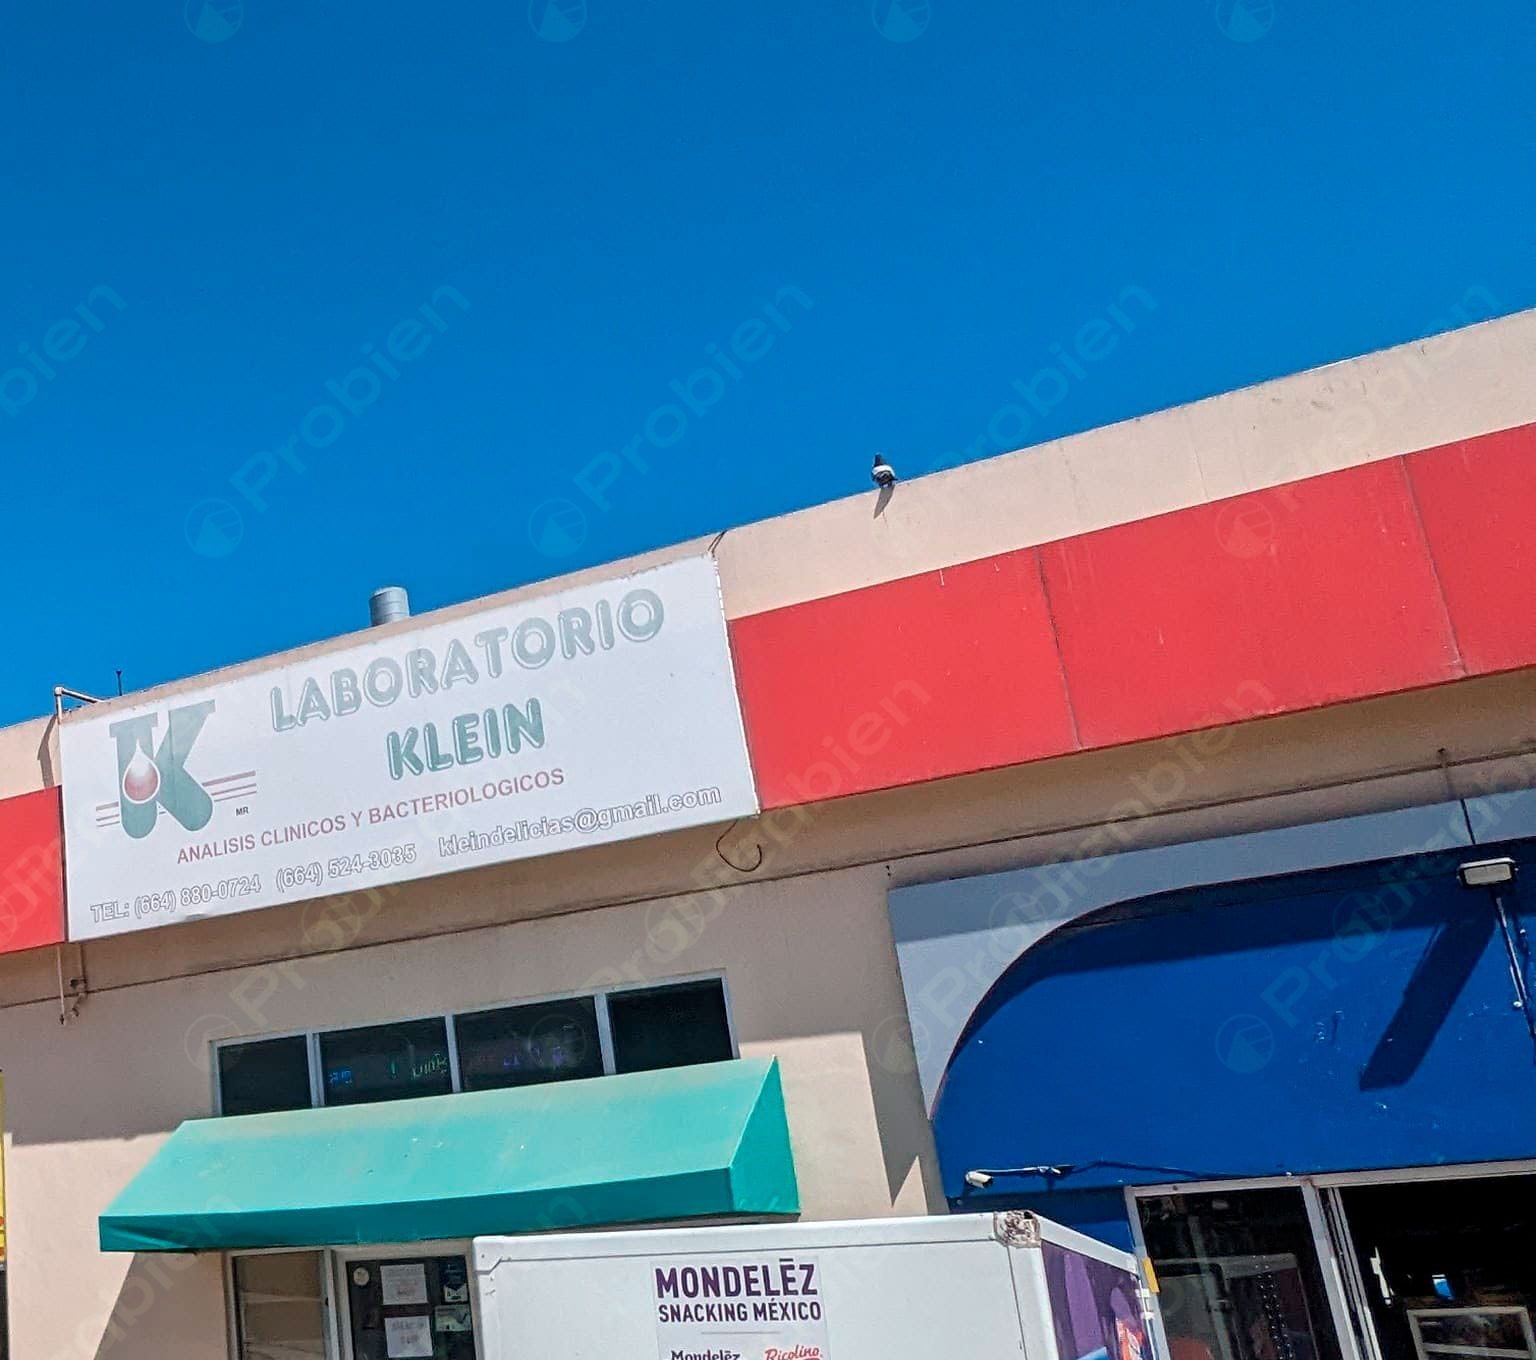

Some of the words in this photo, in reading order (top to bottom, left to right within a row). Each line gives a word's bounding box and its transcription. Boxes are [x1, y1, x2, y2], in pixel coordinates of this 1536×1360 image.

[270, 589, 664, 732] LABORATORIO
[388, 697, 545, 780] KLEIN
[90, 900, 130, 923] TEL:
[134, 891, 176, 919] (664)
[180, 874, 262, 906] 880-0724
[275, 861, 323, 893] (664)
[327, 843, 417, 879] 524-3035
[439, 786, 722, 857] kleindelicias@gmail.com
[177, 834, 256, 864] ANALISIS
[261, 815, 346, 847] CLINICOS
[351, 811, 364, 827] Y
[368, 768, 565, 824] BACTERIOLOGICOS
[658, 1302, 748, 1323] SNACKING
[753, 1298, 821, 1321] MÉXICO
